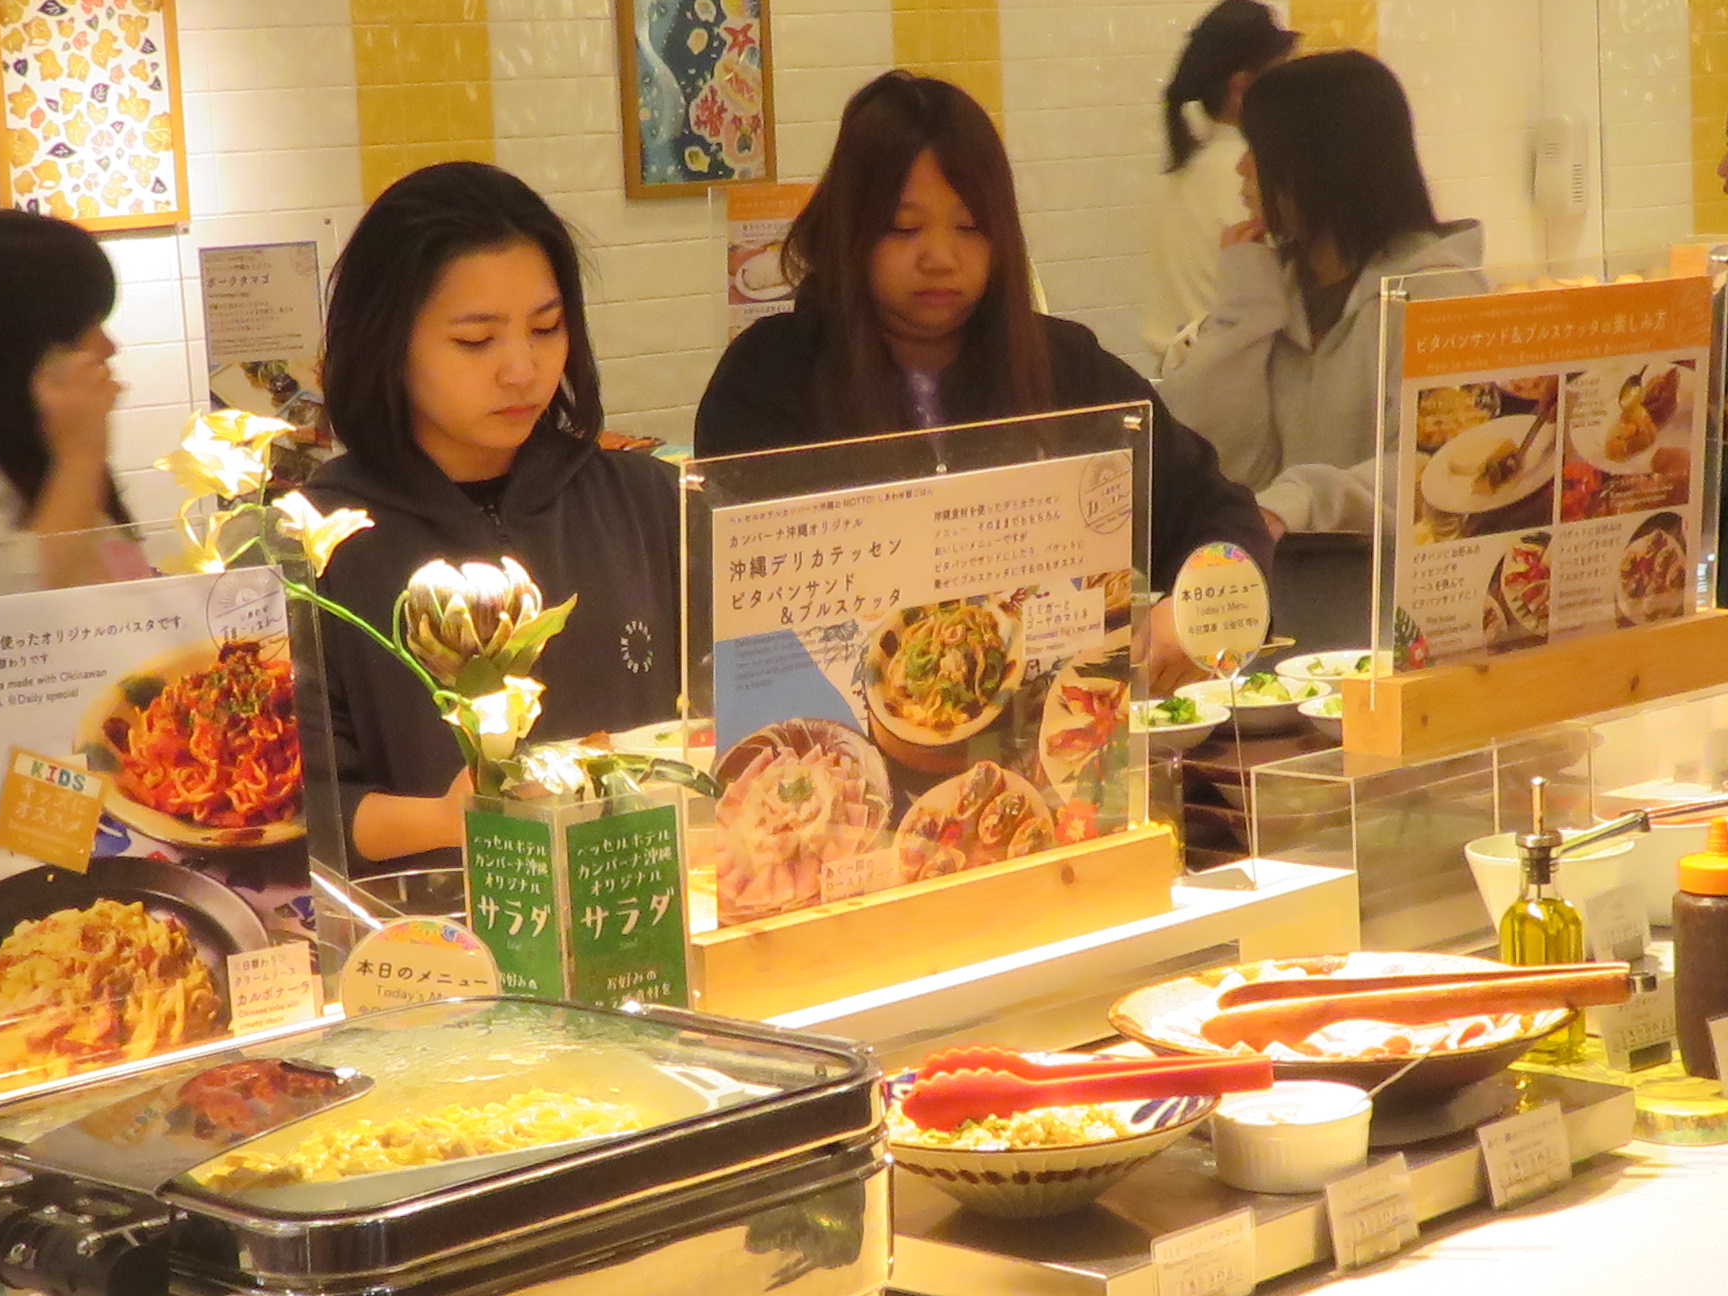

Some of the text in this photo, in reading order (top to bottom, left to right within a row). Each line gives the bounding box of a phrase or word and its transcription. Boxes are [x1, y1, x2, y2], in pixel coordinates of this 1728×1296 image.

[729, 518, 863, 549] カンパーナ沖縄オリジナル
[729, 538, 902, 583] 沖縄デリカテッセン
[731, 573, 856, 610] ピタパンサンド
[1181, 583, 1259, 602] 本日のメニュー
[780, 588, 902, 625] &ブルスケッタ
[7, 675, 34, 689] made
[36, 673, 58, 686] with
[30, 759, 86, 793] KIDS
[473, 835, 547, 857] ベッセルホテル
[577, 830, 670, 857] ベッセルホテル
[475, 853, 549, 876] カンパーナ沖縄
[578, 846, 672, 879] カンパーナ沖縄
[484, 874, 541, 895] オリジナル
[590, 869, 661, 897] オリジナル
[478, 894, 551, 937] サラダ
[580, 887, 675, 940] サラダ
[356, 959, 489, 987] 本日のメニュー
[606, 969, 658, 992] お好みの
[237, 980, 310, 1007] カルボナーラ
[376, 984, 424, 1003] Today's
